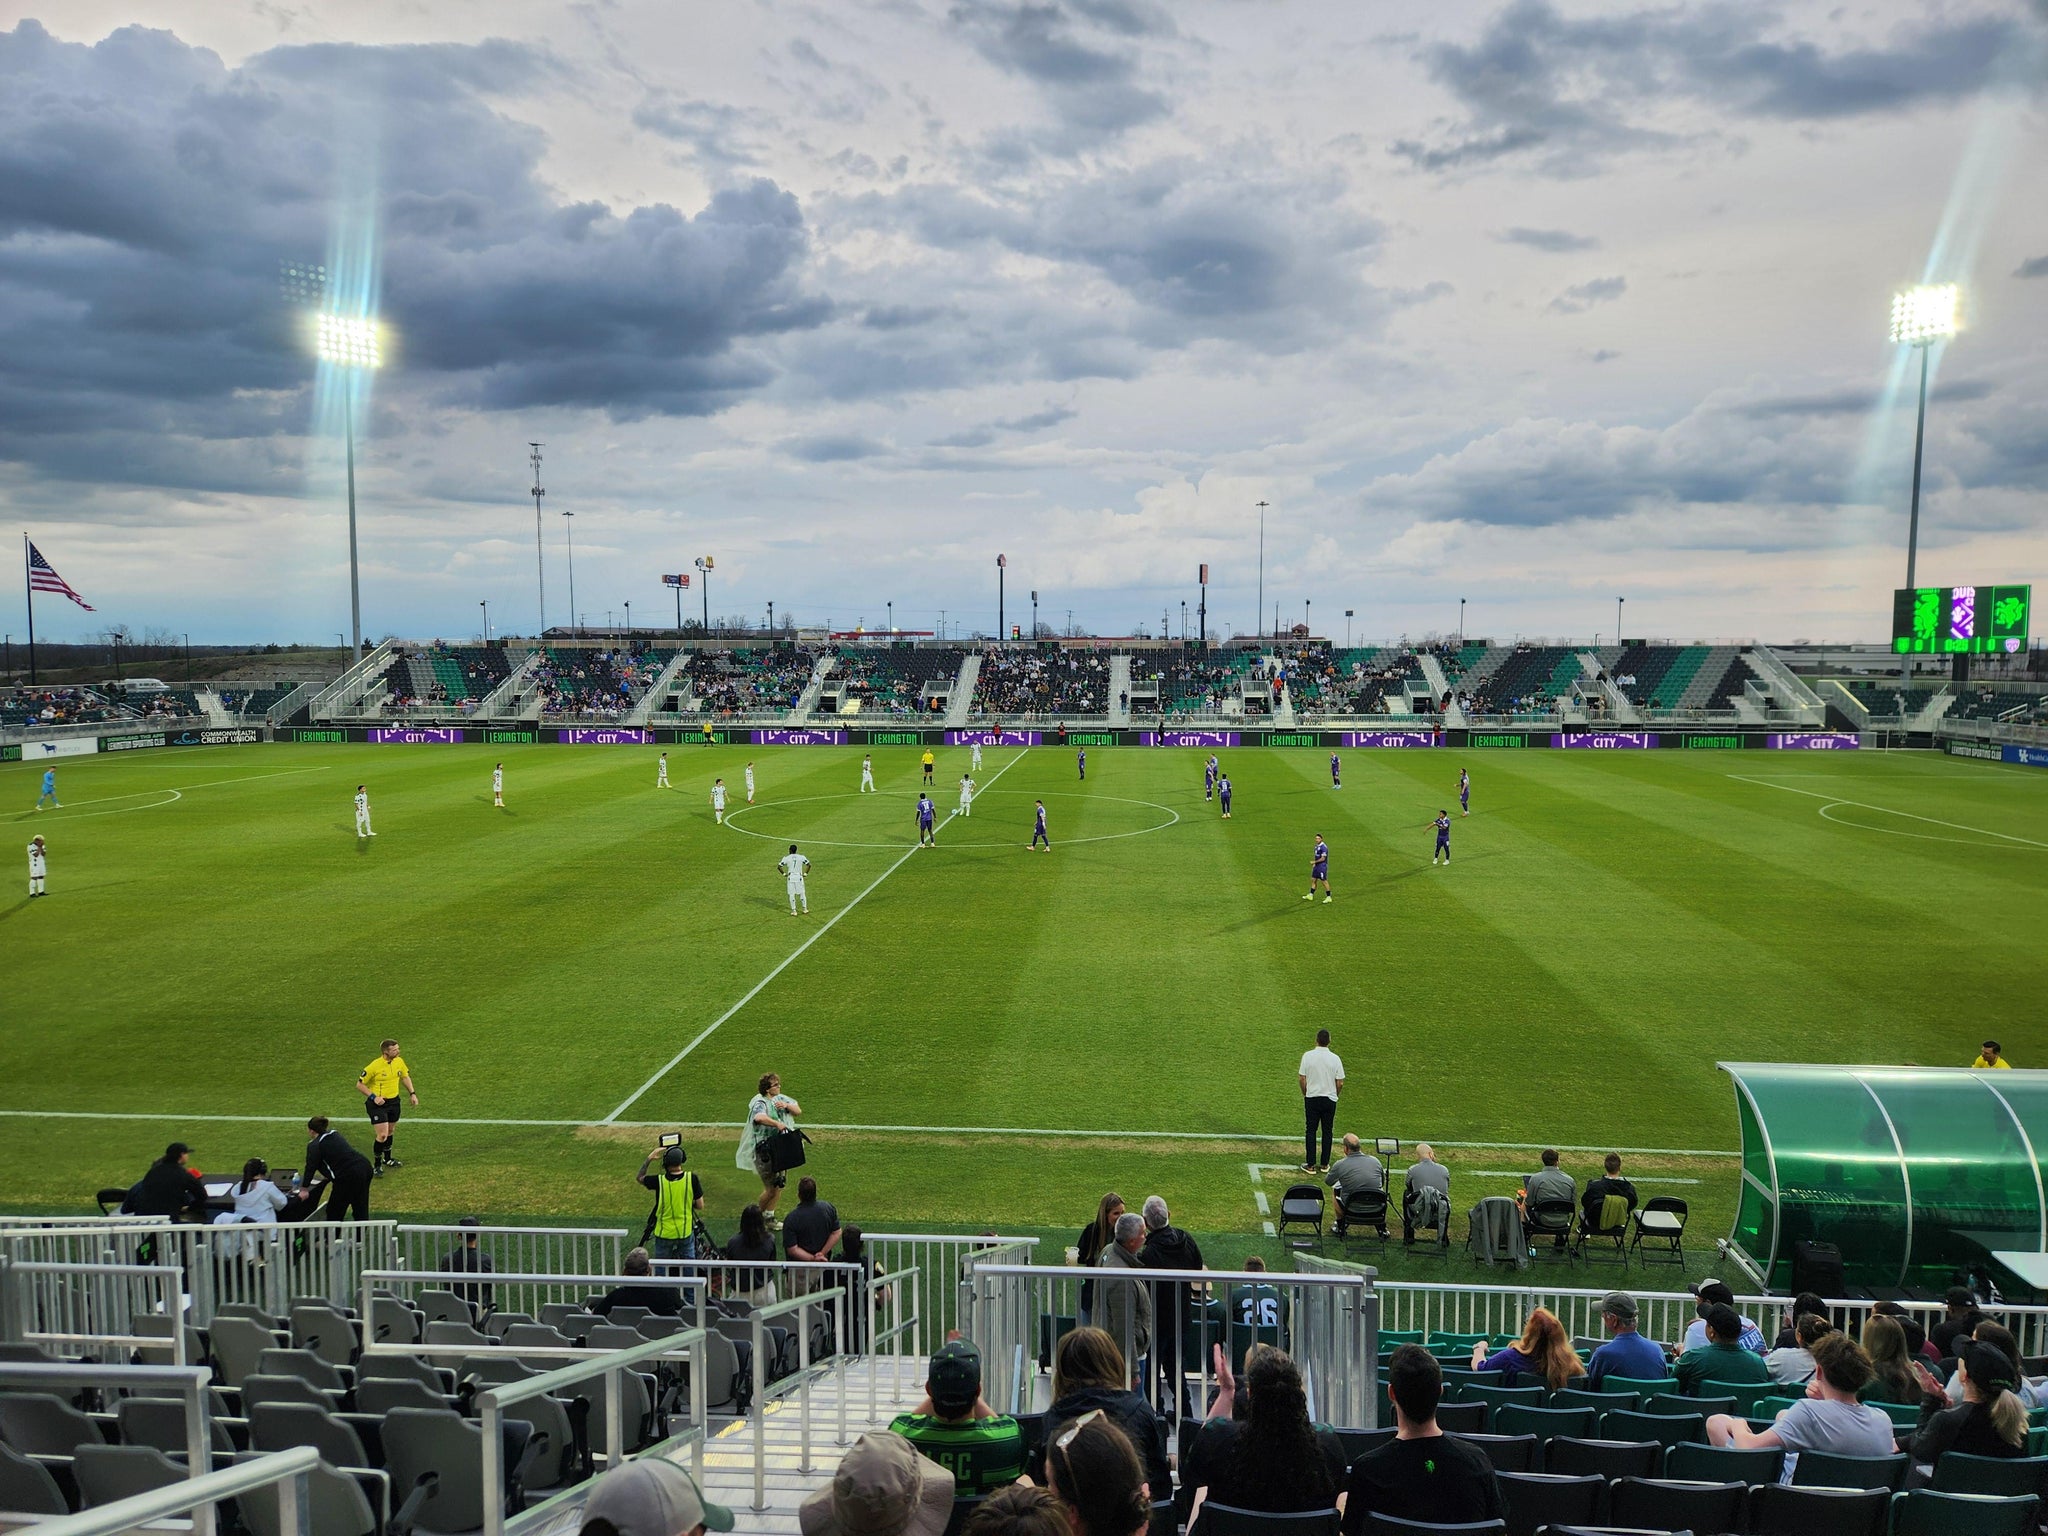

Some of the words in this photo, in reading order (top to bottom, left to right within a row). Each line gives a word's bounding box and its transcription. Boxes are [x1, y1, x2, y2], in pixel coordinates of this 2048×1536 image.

[201, 730, 256, 738] COMMONWEALTH
[201, 736, 228, 744] CREDIT
[231, 735, 257, 743] UNION
[300, 731, 342, 743] LEXINGTON
[405, 733, 427, 743] CITY
[489, 732, 532, 744] LEXINGTON
[597, 733, 618, 743] CITY
[681, 732, 724, 744] LEXINON
[789, 734, 810, 744] CITY
[874, 733, 917, 745] LEXINGTON
[1069, 734, 1112, 746] LEXINGTON
[1179, 736, 1201, 746] CITY
[1268, 735, 1313, 747] LEXINGTON
[1383, 736, 1405, 747] CITY
[1474, 735, 1521, 748] LEXINGTON
[1593, 737, 1617, 748] CITY
[1689, 736, 1737, 749] LEXINGTON
[1809, 738, 1835, 749] CITY
[1242, 1298, 1278, 1326] 26
